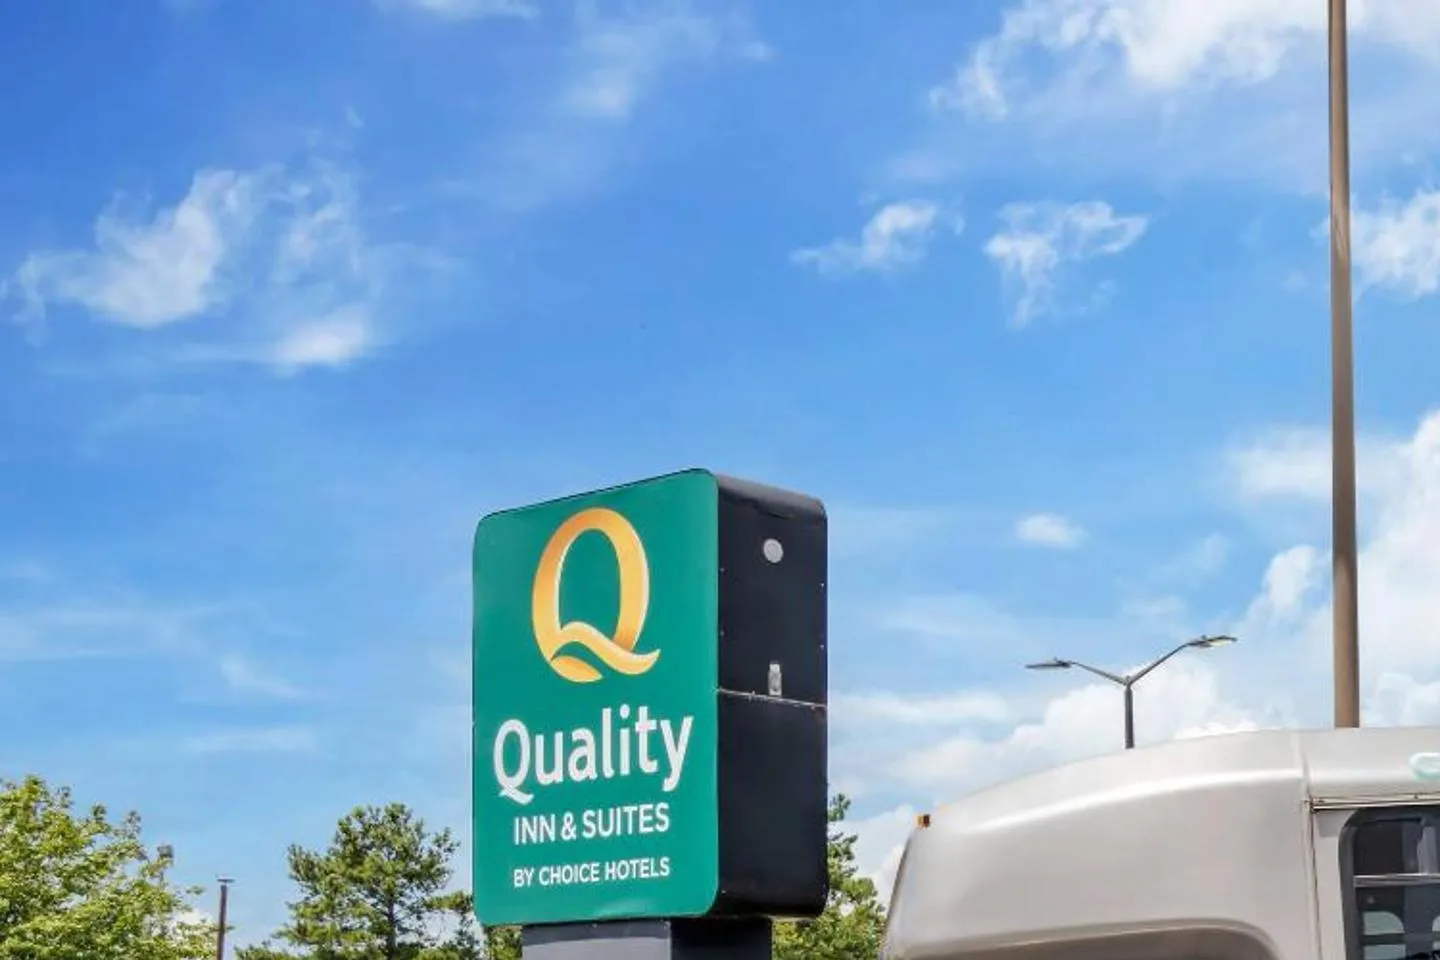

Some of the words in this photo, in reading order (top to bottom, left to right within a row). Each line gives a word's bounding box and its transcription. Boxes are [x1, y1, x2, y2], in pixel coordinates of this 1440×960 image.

[493, 703, 694, 805] Quality
[513, 814, 556, 845] INN
[560, 811, 577, 841] &
[581, 802, 670, 839] SUITES
[513, 867, 534, 888] BY
[538, 861, 600, 887] CHOICE
[604, 856, 670, 880] HOTELS
